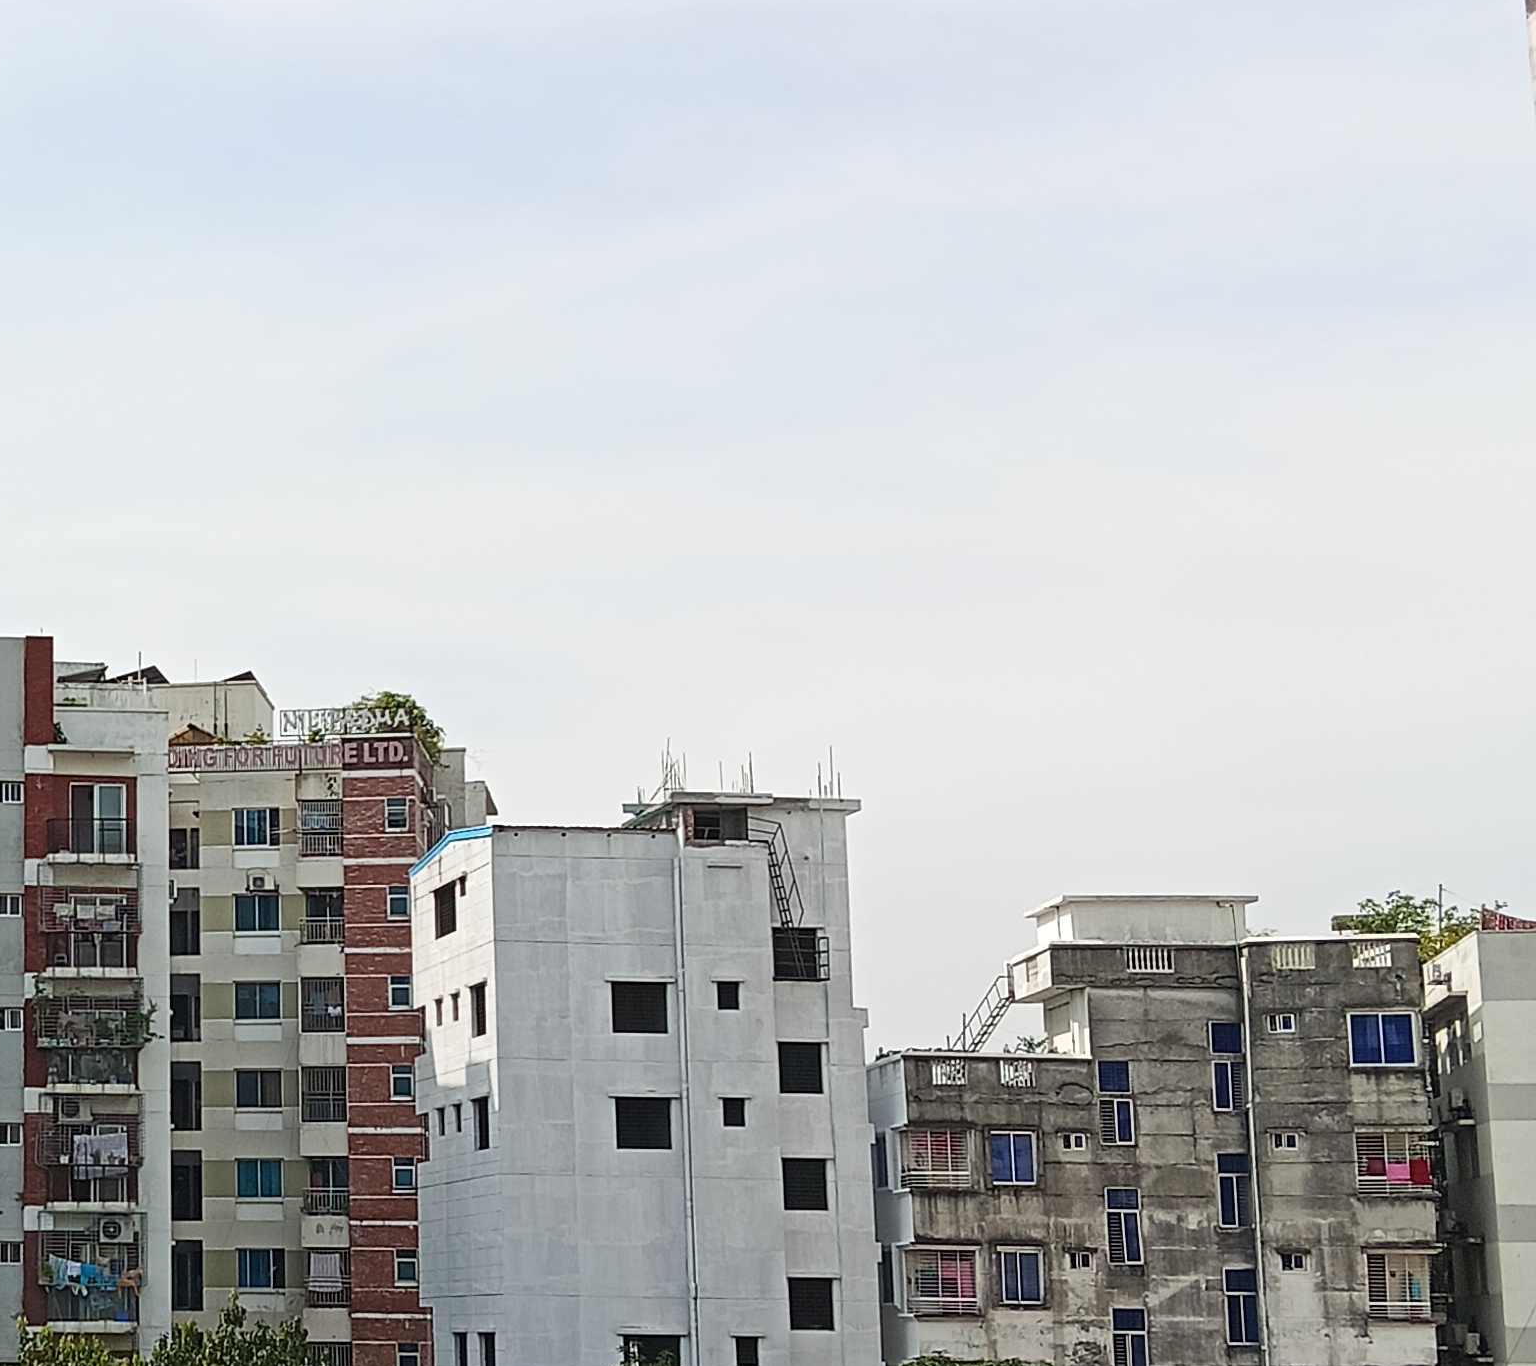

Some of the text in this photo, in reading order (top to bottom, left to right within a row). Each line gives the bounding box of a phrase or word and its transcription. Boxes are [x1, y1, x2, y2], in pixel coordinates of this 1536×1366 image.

[224, 746, 265, 767] FOR
[272, 742, 358, 766] FUTURE
[366, 740, 410, 764] LTD.
